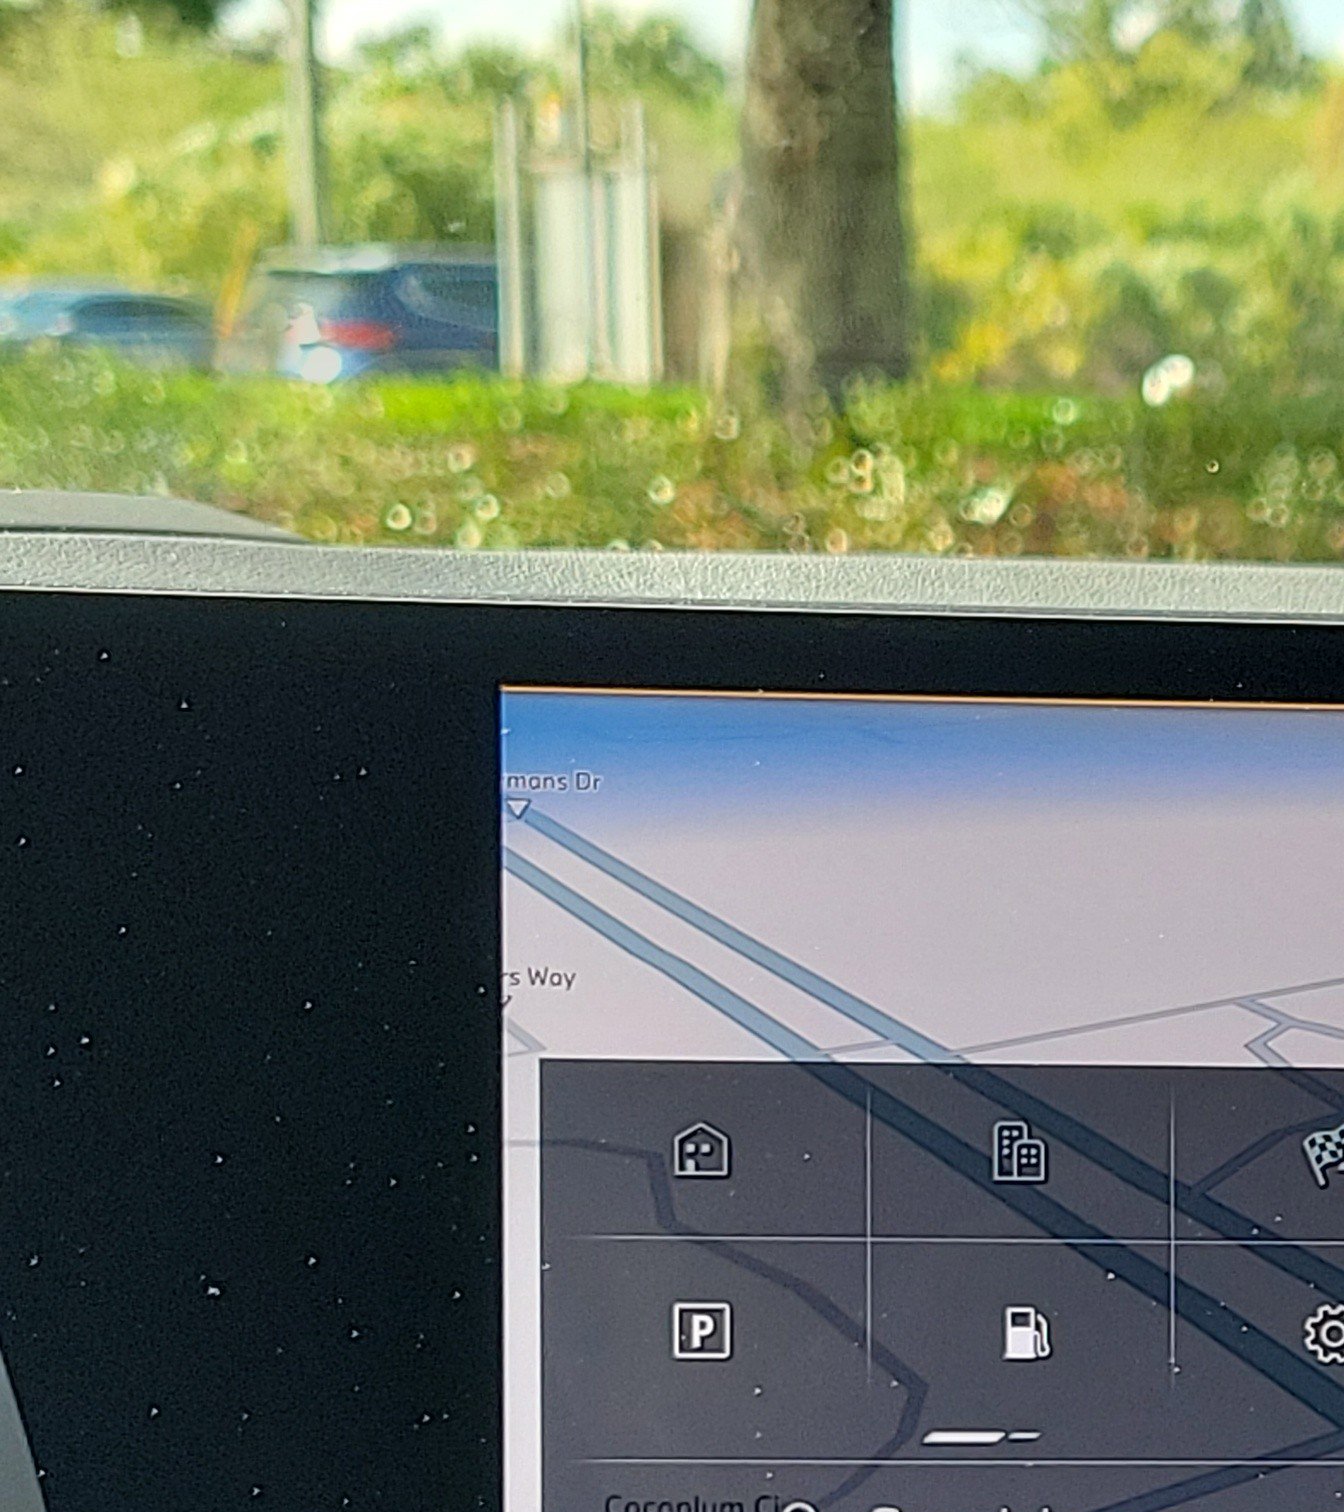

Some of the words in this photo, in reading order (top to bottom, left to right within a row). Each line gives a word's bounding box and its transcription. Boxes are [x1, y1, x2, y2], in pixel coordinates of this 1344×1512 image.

[502, 773, 568, 792] mans
[576, 772, 602, 791] Dr
[527, 968, 577, 991] Way
